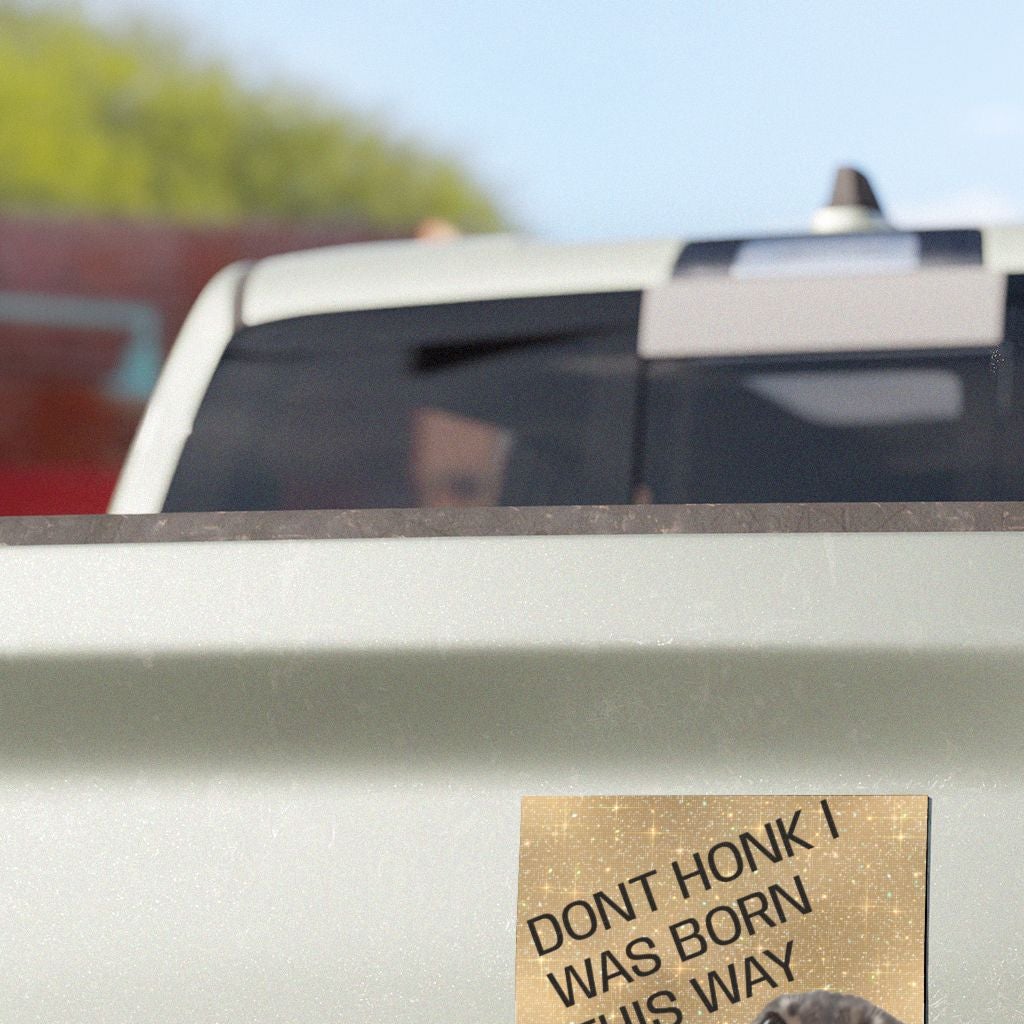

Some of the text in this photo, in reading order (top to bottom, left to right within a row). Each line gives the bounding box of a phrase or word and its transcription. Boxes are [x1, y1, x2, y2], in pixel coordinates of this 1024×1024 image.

[526, 799, 840, 957] DONT HONK I
[546, 874, 813, 1008] WAS BORN
[689, 940, 795, 1014] WAY
